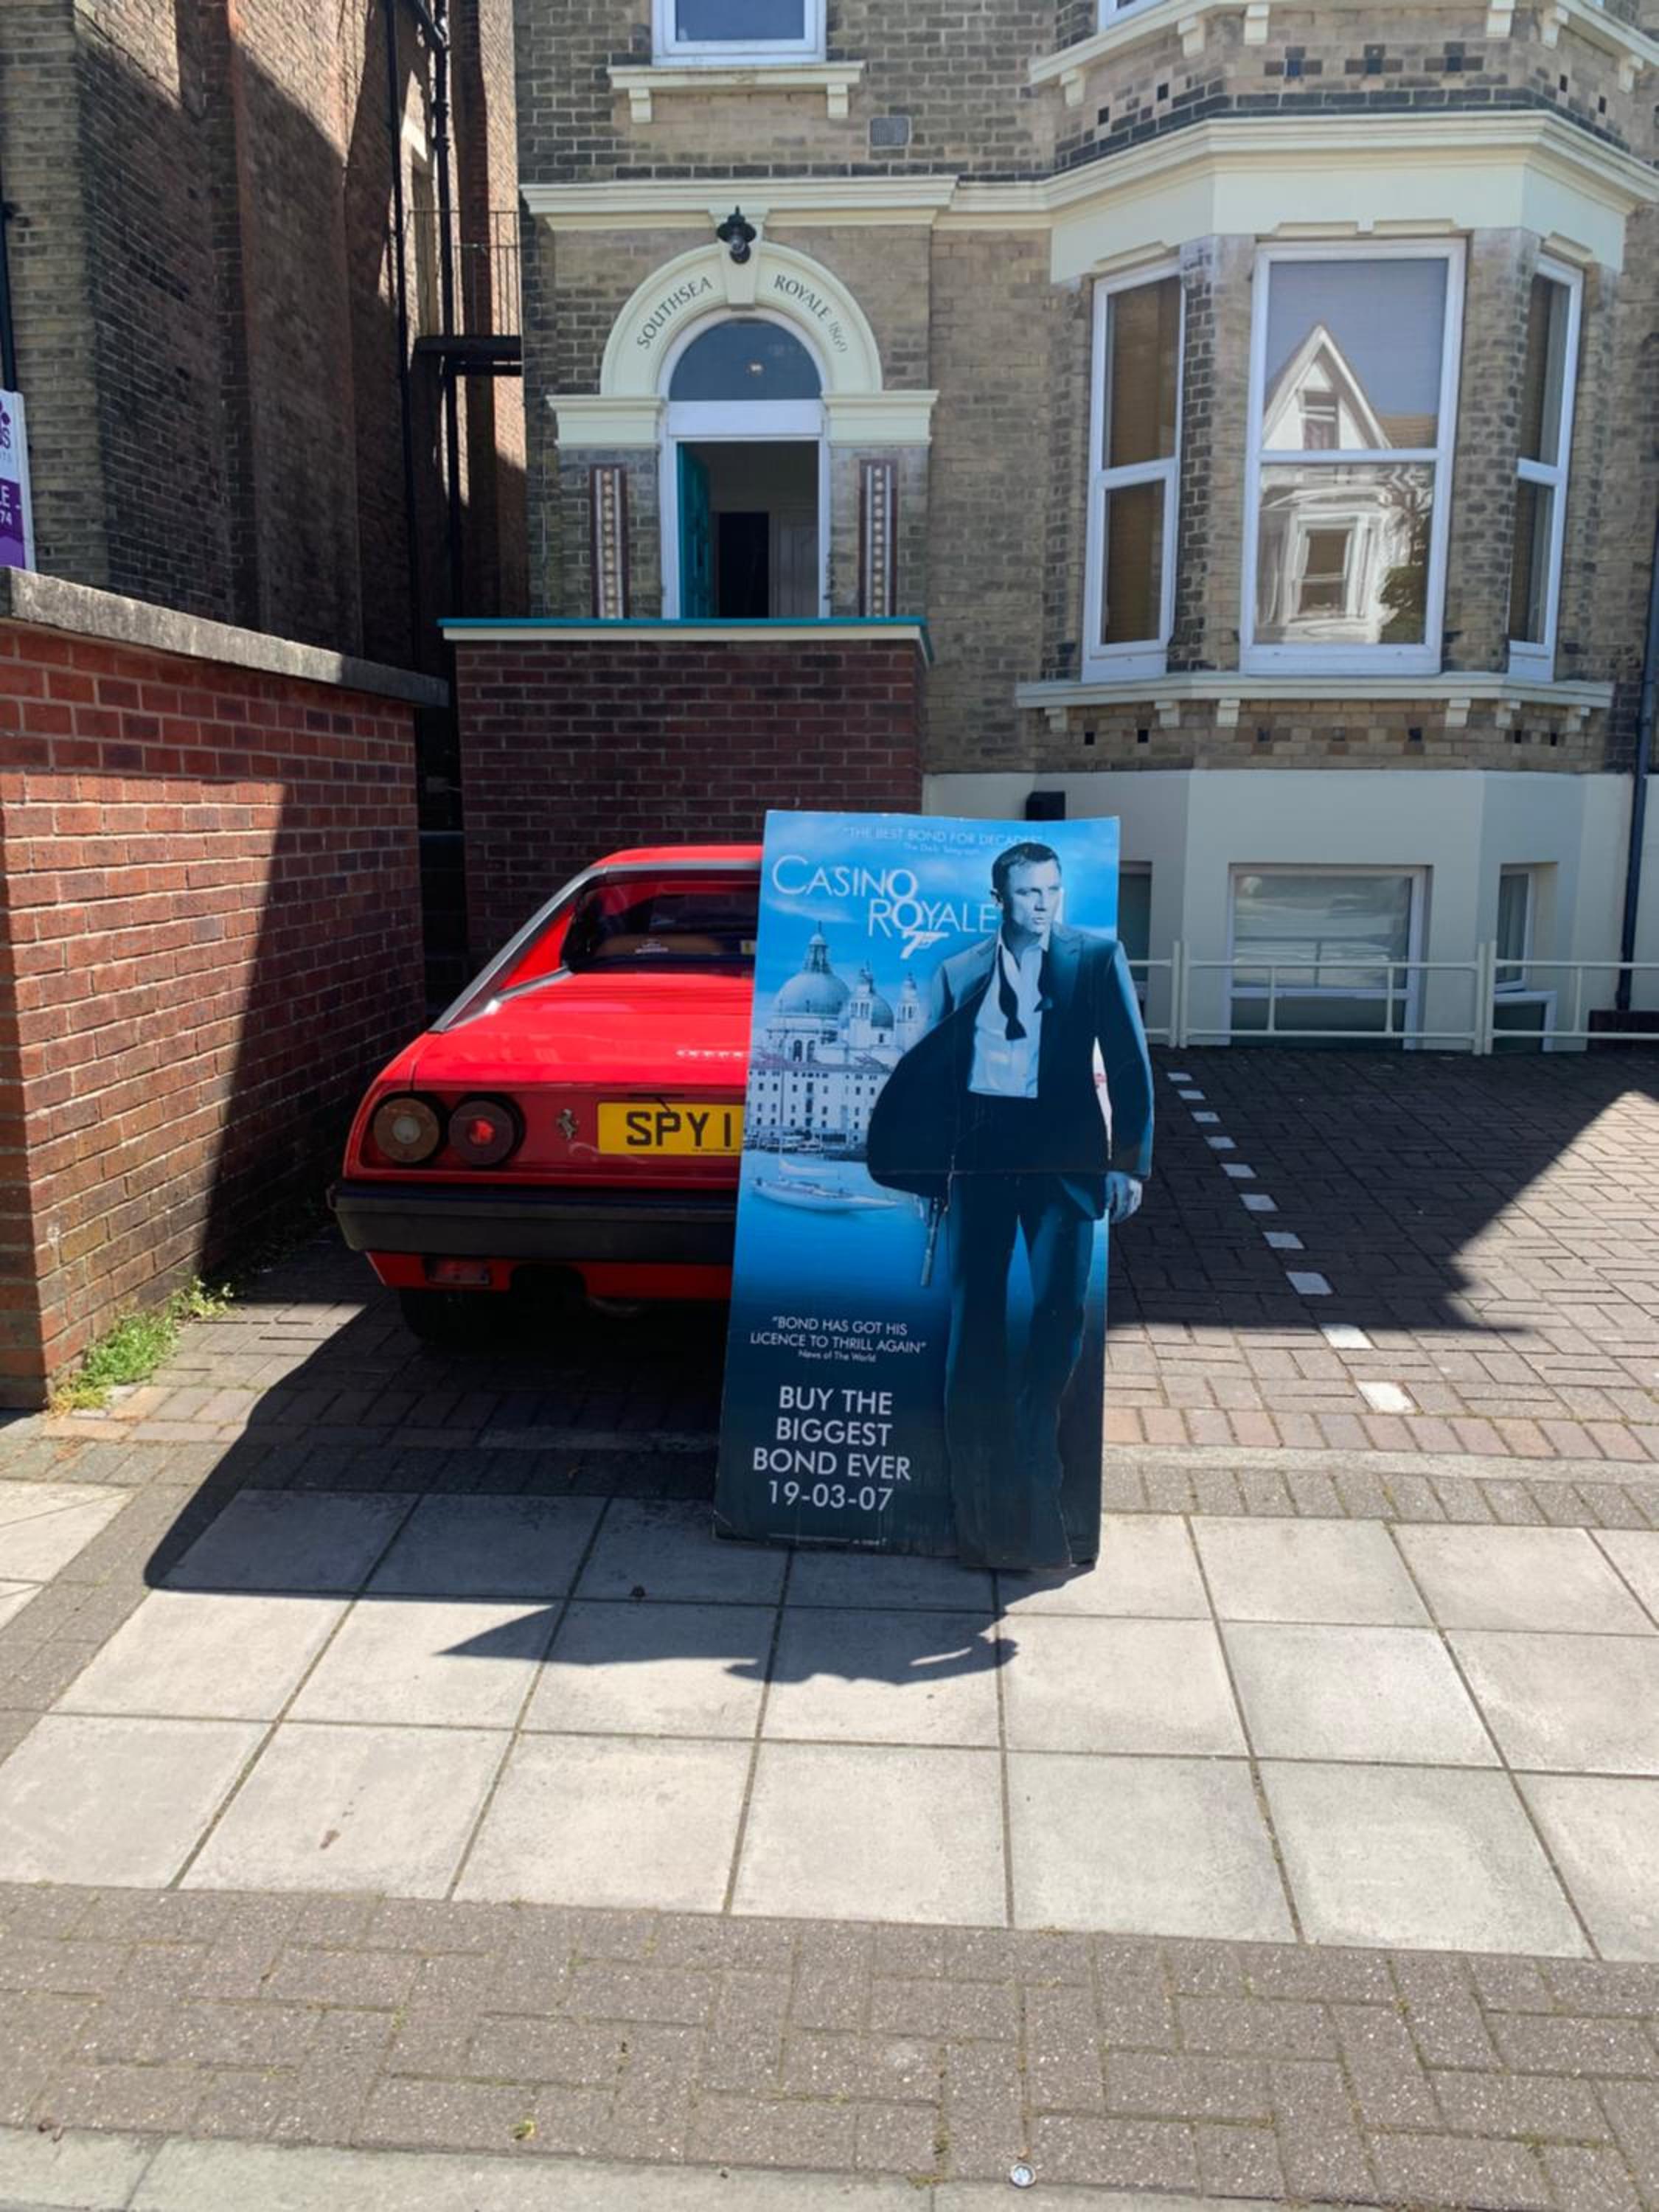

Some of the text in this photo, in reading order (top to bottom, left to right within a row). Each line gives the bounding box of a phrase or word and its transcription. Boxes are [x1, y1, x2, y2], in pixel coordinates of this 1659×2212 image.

[637, 276, 713, 349] SOUTHSEA
[774, 274, 832, 321] ROYALE
[908, 829, 945, 842] BOND
[868, 898, 997, 938] ROYALE
[627, 1111, 710, 1147] SPY
[750, 1332, 806, 1346] LICENCE
[810, 1335, 830, 1348] TO
[833, 1336, 873, 1351] THRILL
[822, 1318, 849, 1332] HAS
[852, 1321, 883, 1335] GOT
[886, 1323, 908, 1336] HIS
[798, 1349, 821, 1360] News
[823, 1350, 832, 1360] of
[851, 1352, 877, 1363] World
[779, 1385, 892, 1415] BUY THE
[776, 1416, 892, 1447] BIGGEST
[753, 1447, 911, 1481] BOND EVER
[769, 1481, 893, 1511] 19-03-07
